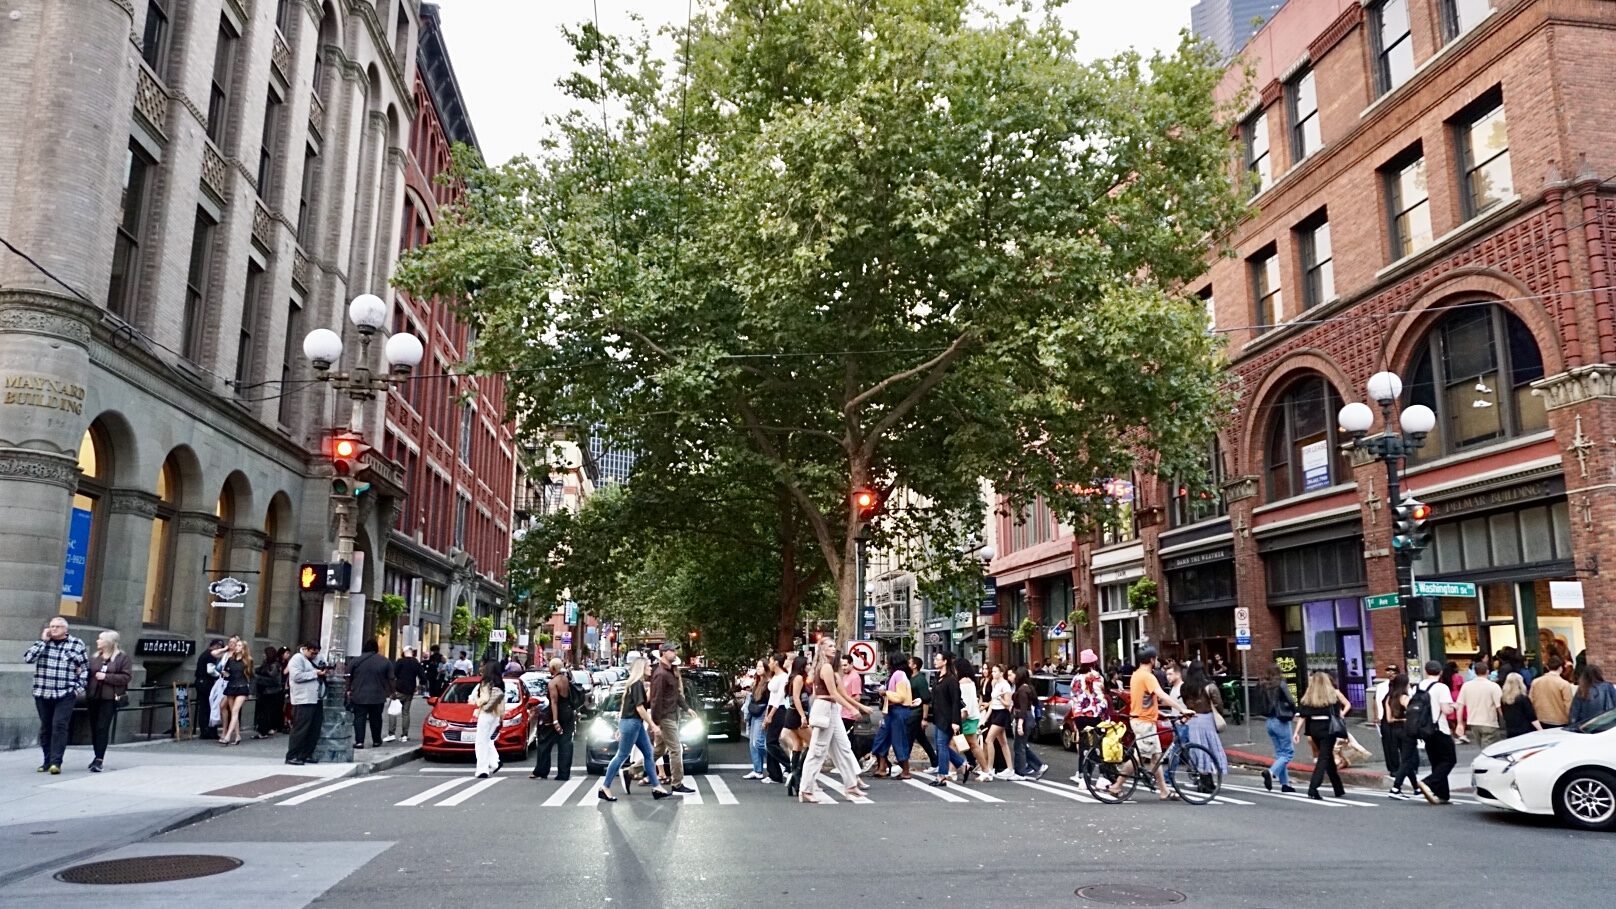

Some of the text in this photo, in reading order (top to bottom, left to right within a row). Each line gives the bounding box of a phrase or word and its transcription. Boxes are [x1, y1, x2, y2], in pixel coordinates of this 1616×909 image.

[5, 377, 85, 400] MAYNARD
[4, 391, 83, 415] BUILDING
[1491, 484, 1539, 503] BUILDING
[1420, 583, 1459, 595] Washington
[143, 640, 191, 655] underbelly
